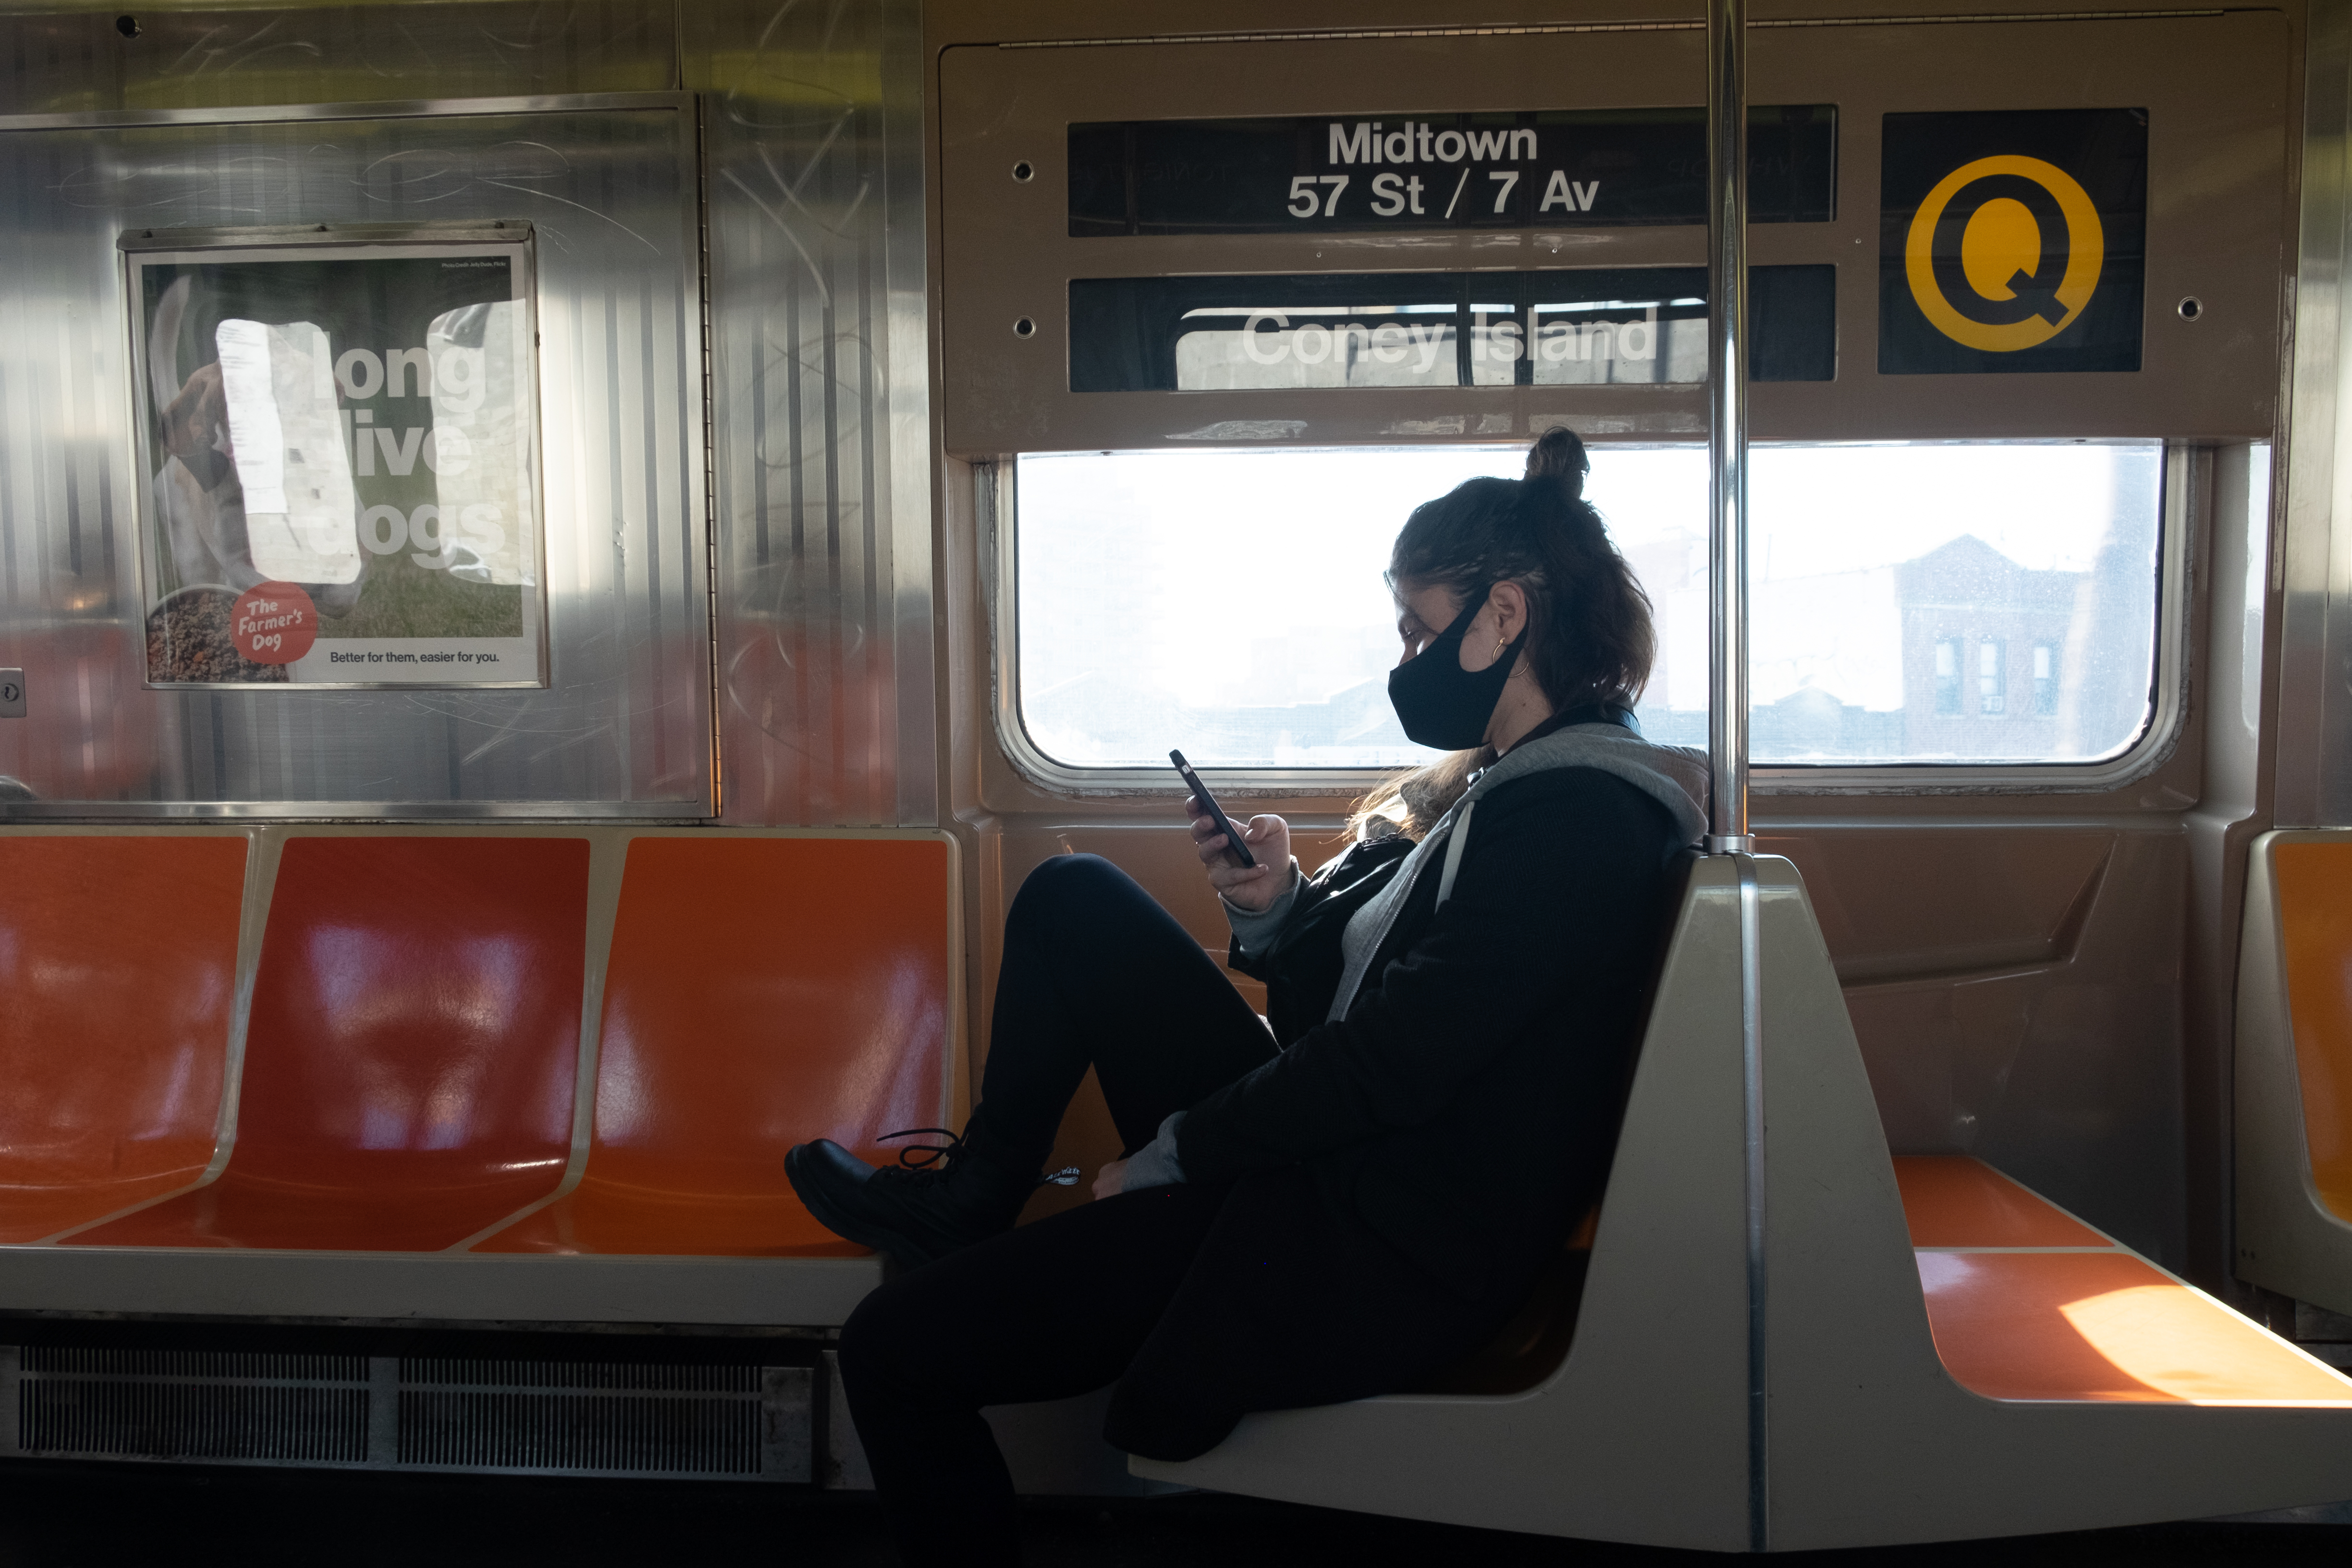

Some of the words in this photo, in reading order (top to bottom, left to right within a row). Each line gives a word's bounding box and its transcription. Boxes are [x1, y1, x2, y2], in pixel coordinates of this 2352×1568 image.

[1329, 122, 1537, 164] Midtown
[1287, 175, 1349, 218] 57
[1371, 173, 1425, 216] St
[1489, 171, 1519, 213] 7
[1540, 170, 1600, 211] Av
[1931, 173, 2070, 328] Q
[1243, 308, 1446, 373] Coney
[1474, 307, 1657, 361] Island
[313, 331, 486, 413] long
[334, 409, 472, 476] live
[238, 608, 303, 636] Farmer's
[246, 599, 279, 616] The
[252, 634, 282, 652] Dog
[331, 652, 365, 662] Better
[368, 652, 383, 662] for
[386, 651, 418, 664] them,
[420, 651, 455, 662] easier
[458, 651, 473, 662] for
[476, 653, 500, 664] you.
